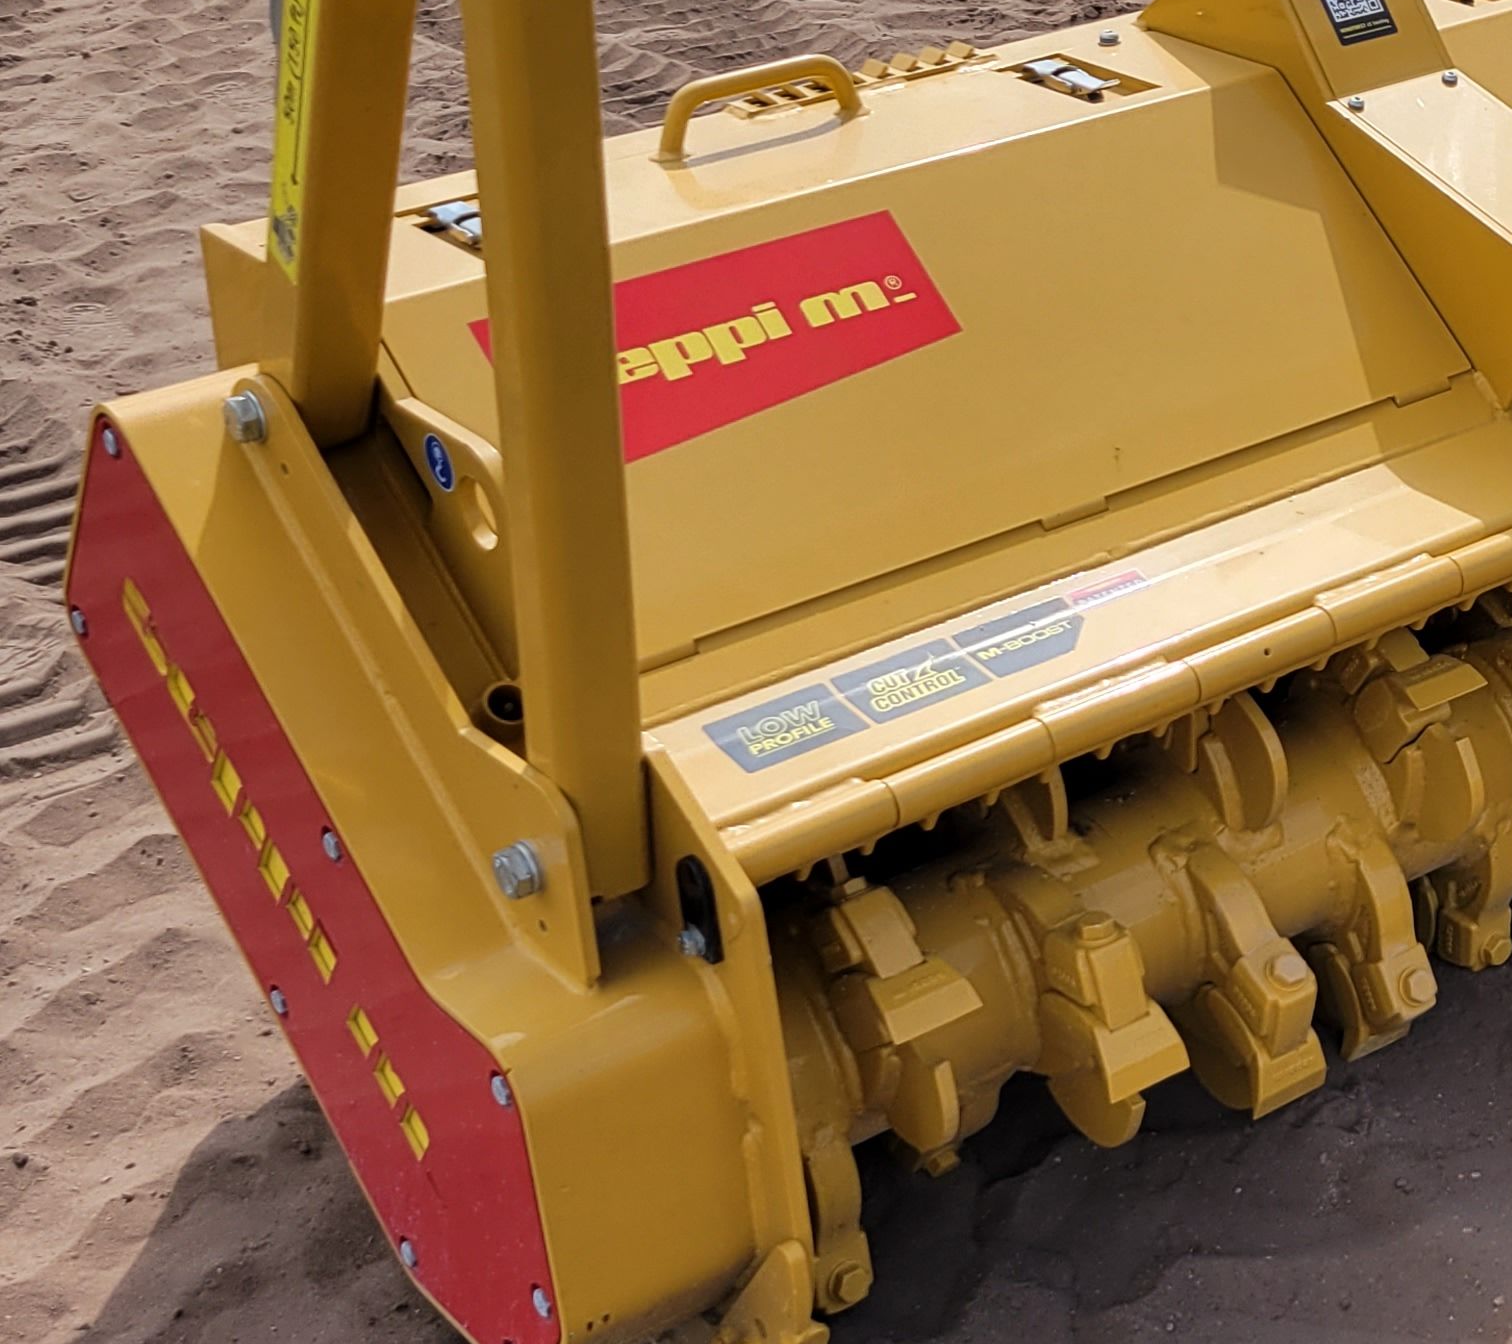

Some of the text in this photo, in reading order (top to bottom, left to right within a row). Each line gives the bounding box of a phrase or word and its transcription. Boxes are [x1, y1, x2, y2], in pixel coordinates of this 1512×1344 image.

[616, 301, 793, 385] eppi
[975, 619, 1073, 661] M-BOOST
[867, 668, 910, 695] CUT
[871, 668, 965, 711] CONTROL
[736, 699, 822, 745] LOW
[749, 716, 836, 755] PROFILE
